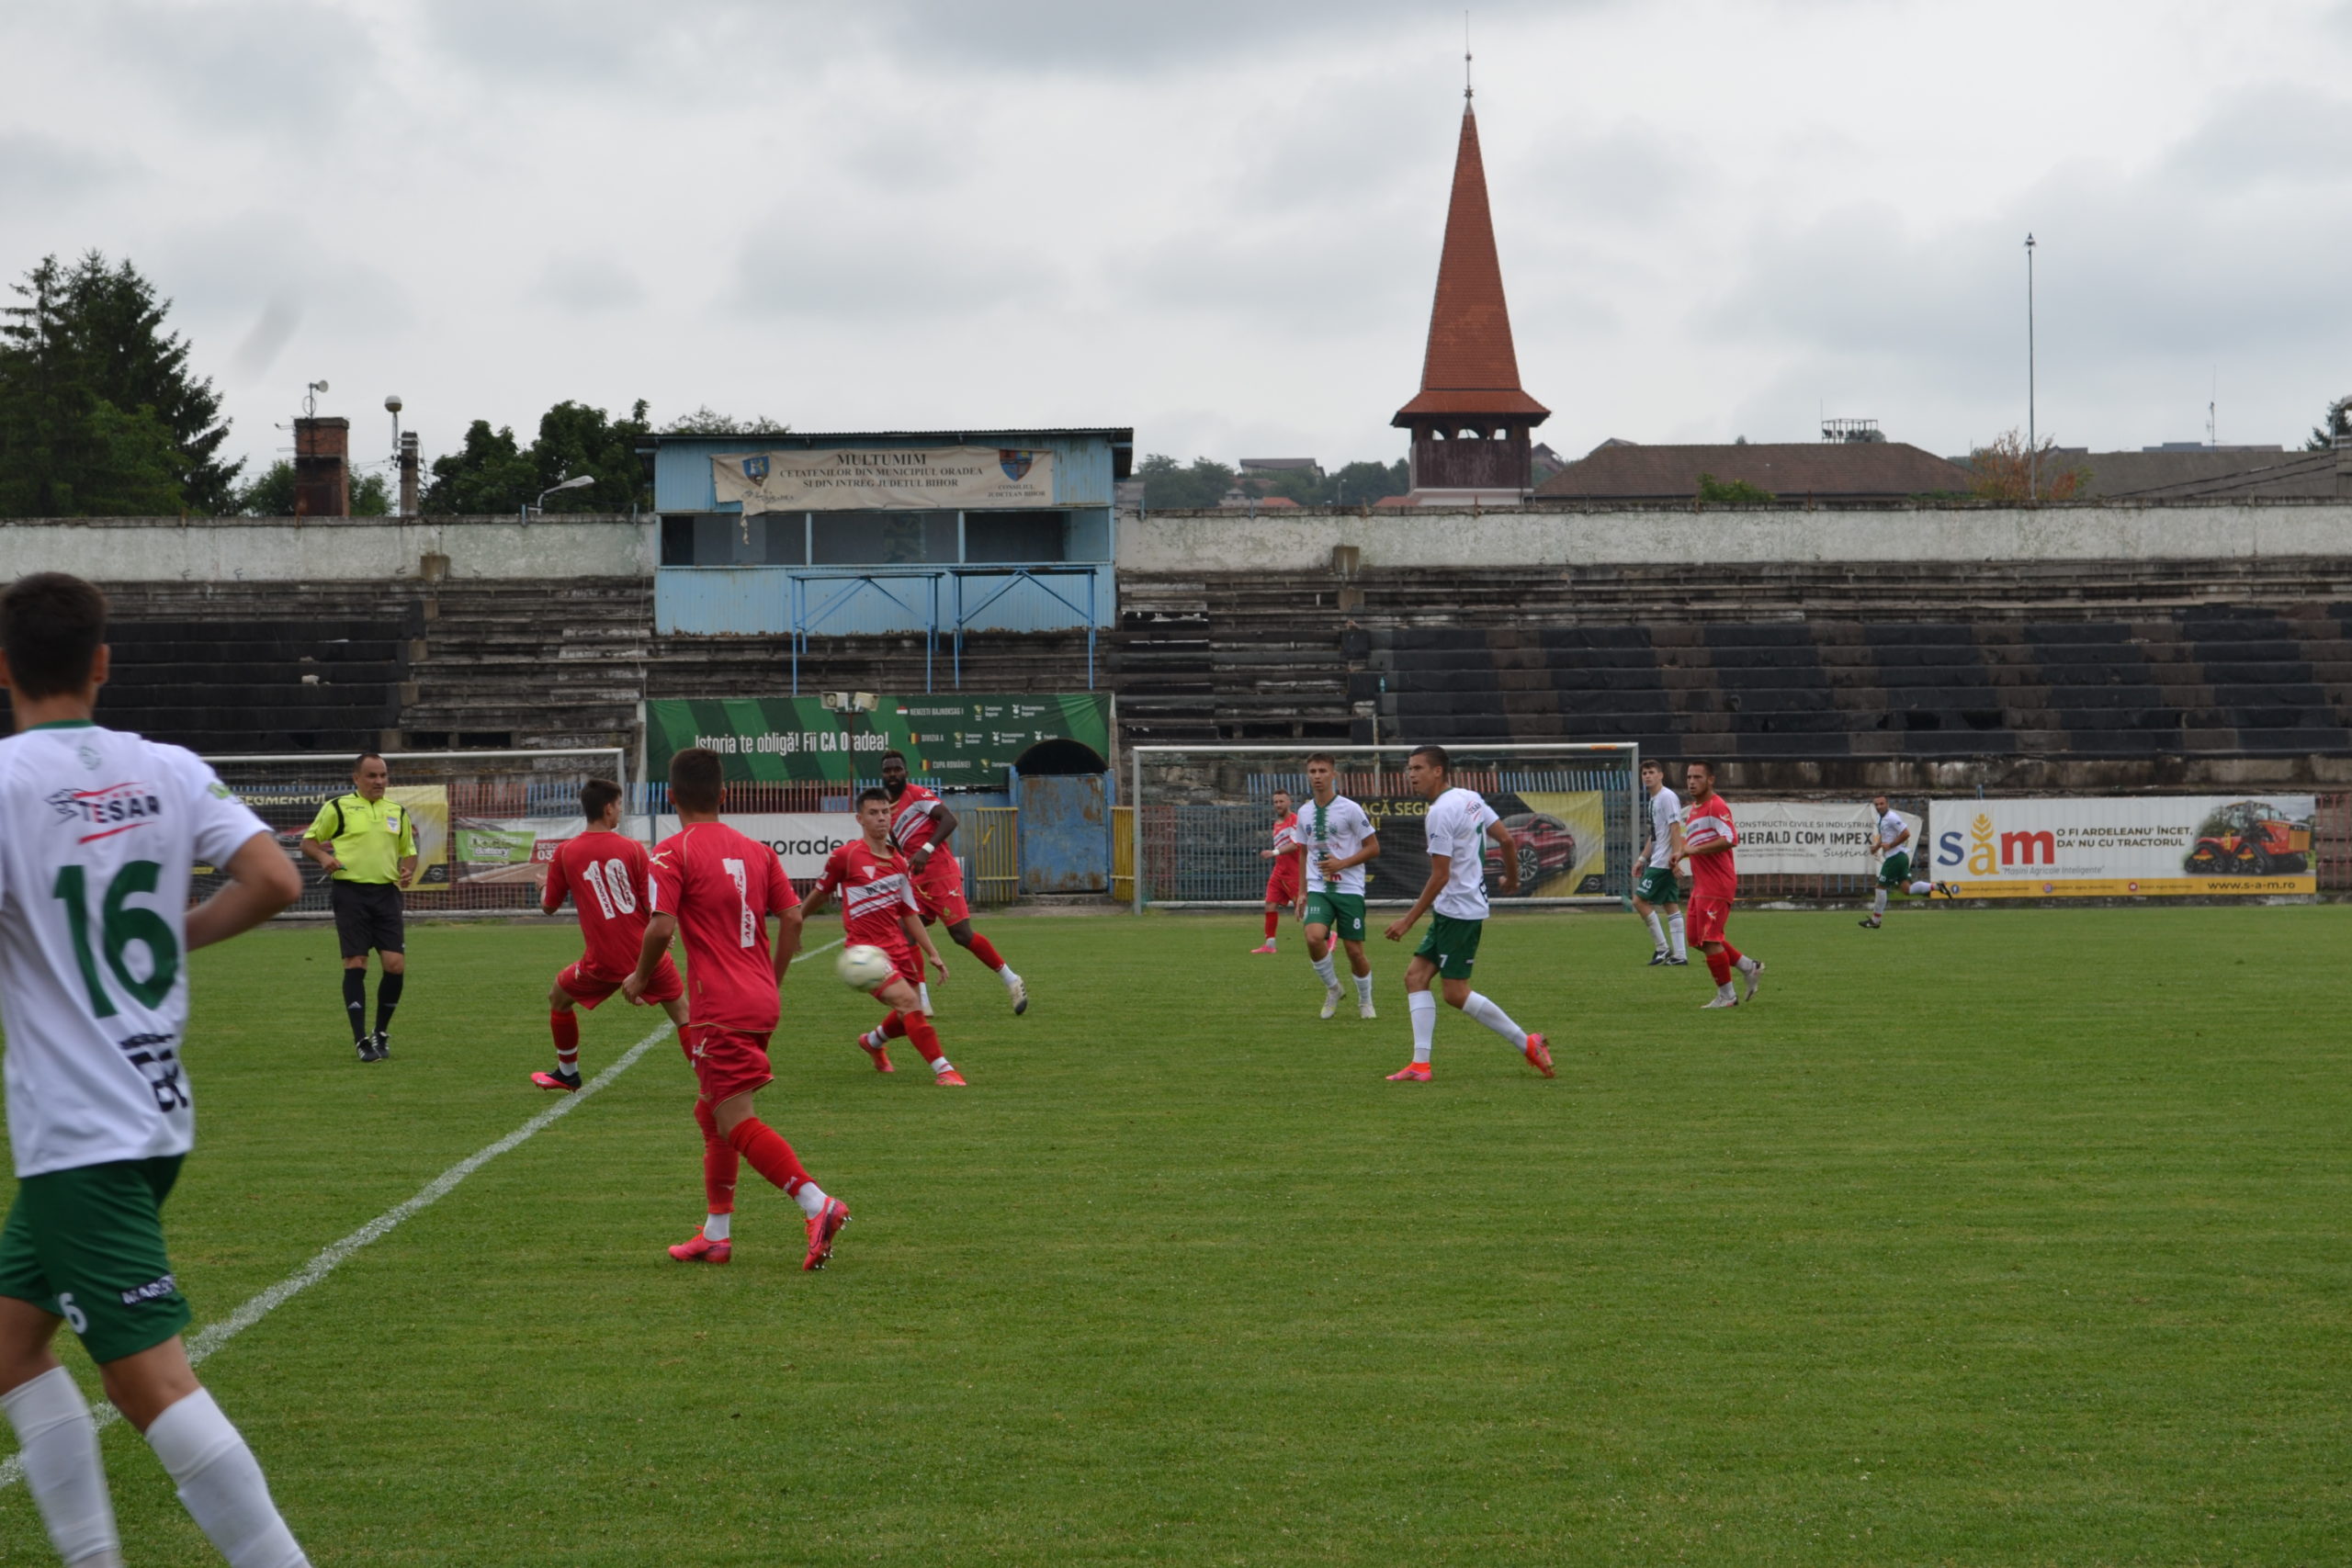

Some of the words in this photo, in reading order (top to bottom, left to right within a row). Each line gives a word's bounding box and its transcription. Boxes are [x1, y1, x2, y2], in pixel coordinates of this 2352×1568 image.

[836, 454, 927, 466] MULTUMIM
[780, 468, 851, 478] CETATENILOR
[855, 468, 873, 477] DIN
[876, 468, 937, 477] MUNICIPIUL
[940, 467, 983, 476] ORADEA
[815, 479, 833, 487] DIN
[835, 479, 875, 487] INTREG
[877, 479, 923, 488] JUDETUL
[925, 479, 958, 487] BIHOR
[695, 735, 736, 753] Istoria
[740, 734, 752, 753] te
[756, 732, 799, 756] obligă!
[803, 732, 817, 751] Fii
[820, 732, 837, 751] CA
[1790, 820, 1814, 829] CIVILE
[1737, 830, 1791, 844] HERALD
[1795, 831, 1826, 844] COM
[1830, 832, 1872, 844] IMPEX
[2069, 828, 2079, 836] FI
[2078, 839, 2096, 847] NU
[2098, 839, 2114, 847] CU
[2117, 838, 2185, 847] TRACTORUL
[583, 857, 637, 919] 10
[1642, 878, 1653, 889] 43
[2208, 879, 2295, 891] www.s-a-m.ro
[1353, 918, 1362, 930] 8
[53, 860, 180, 1019] 16
[1440, 954, 1448, 968] 7
